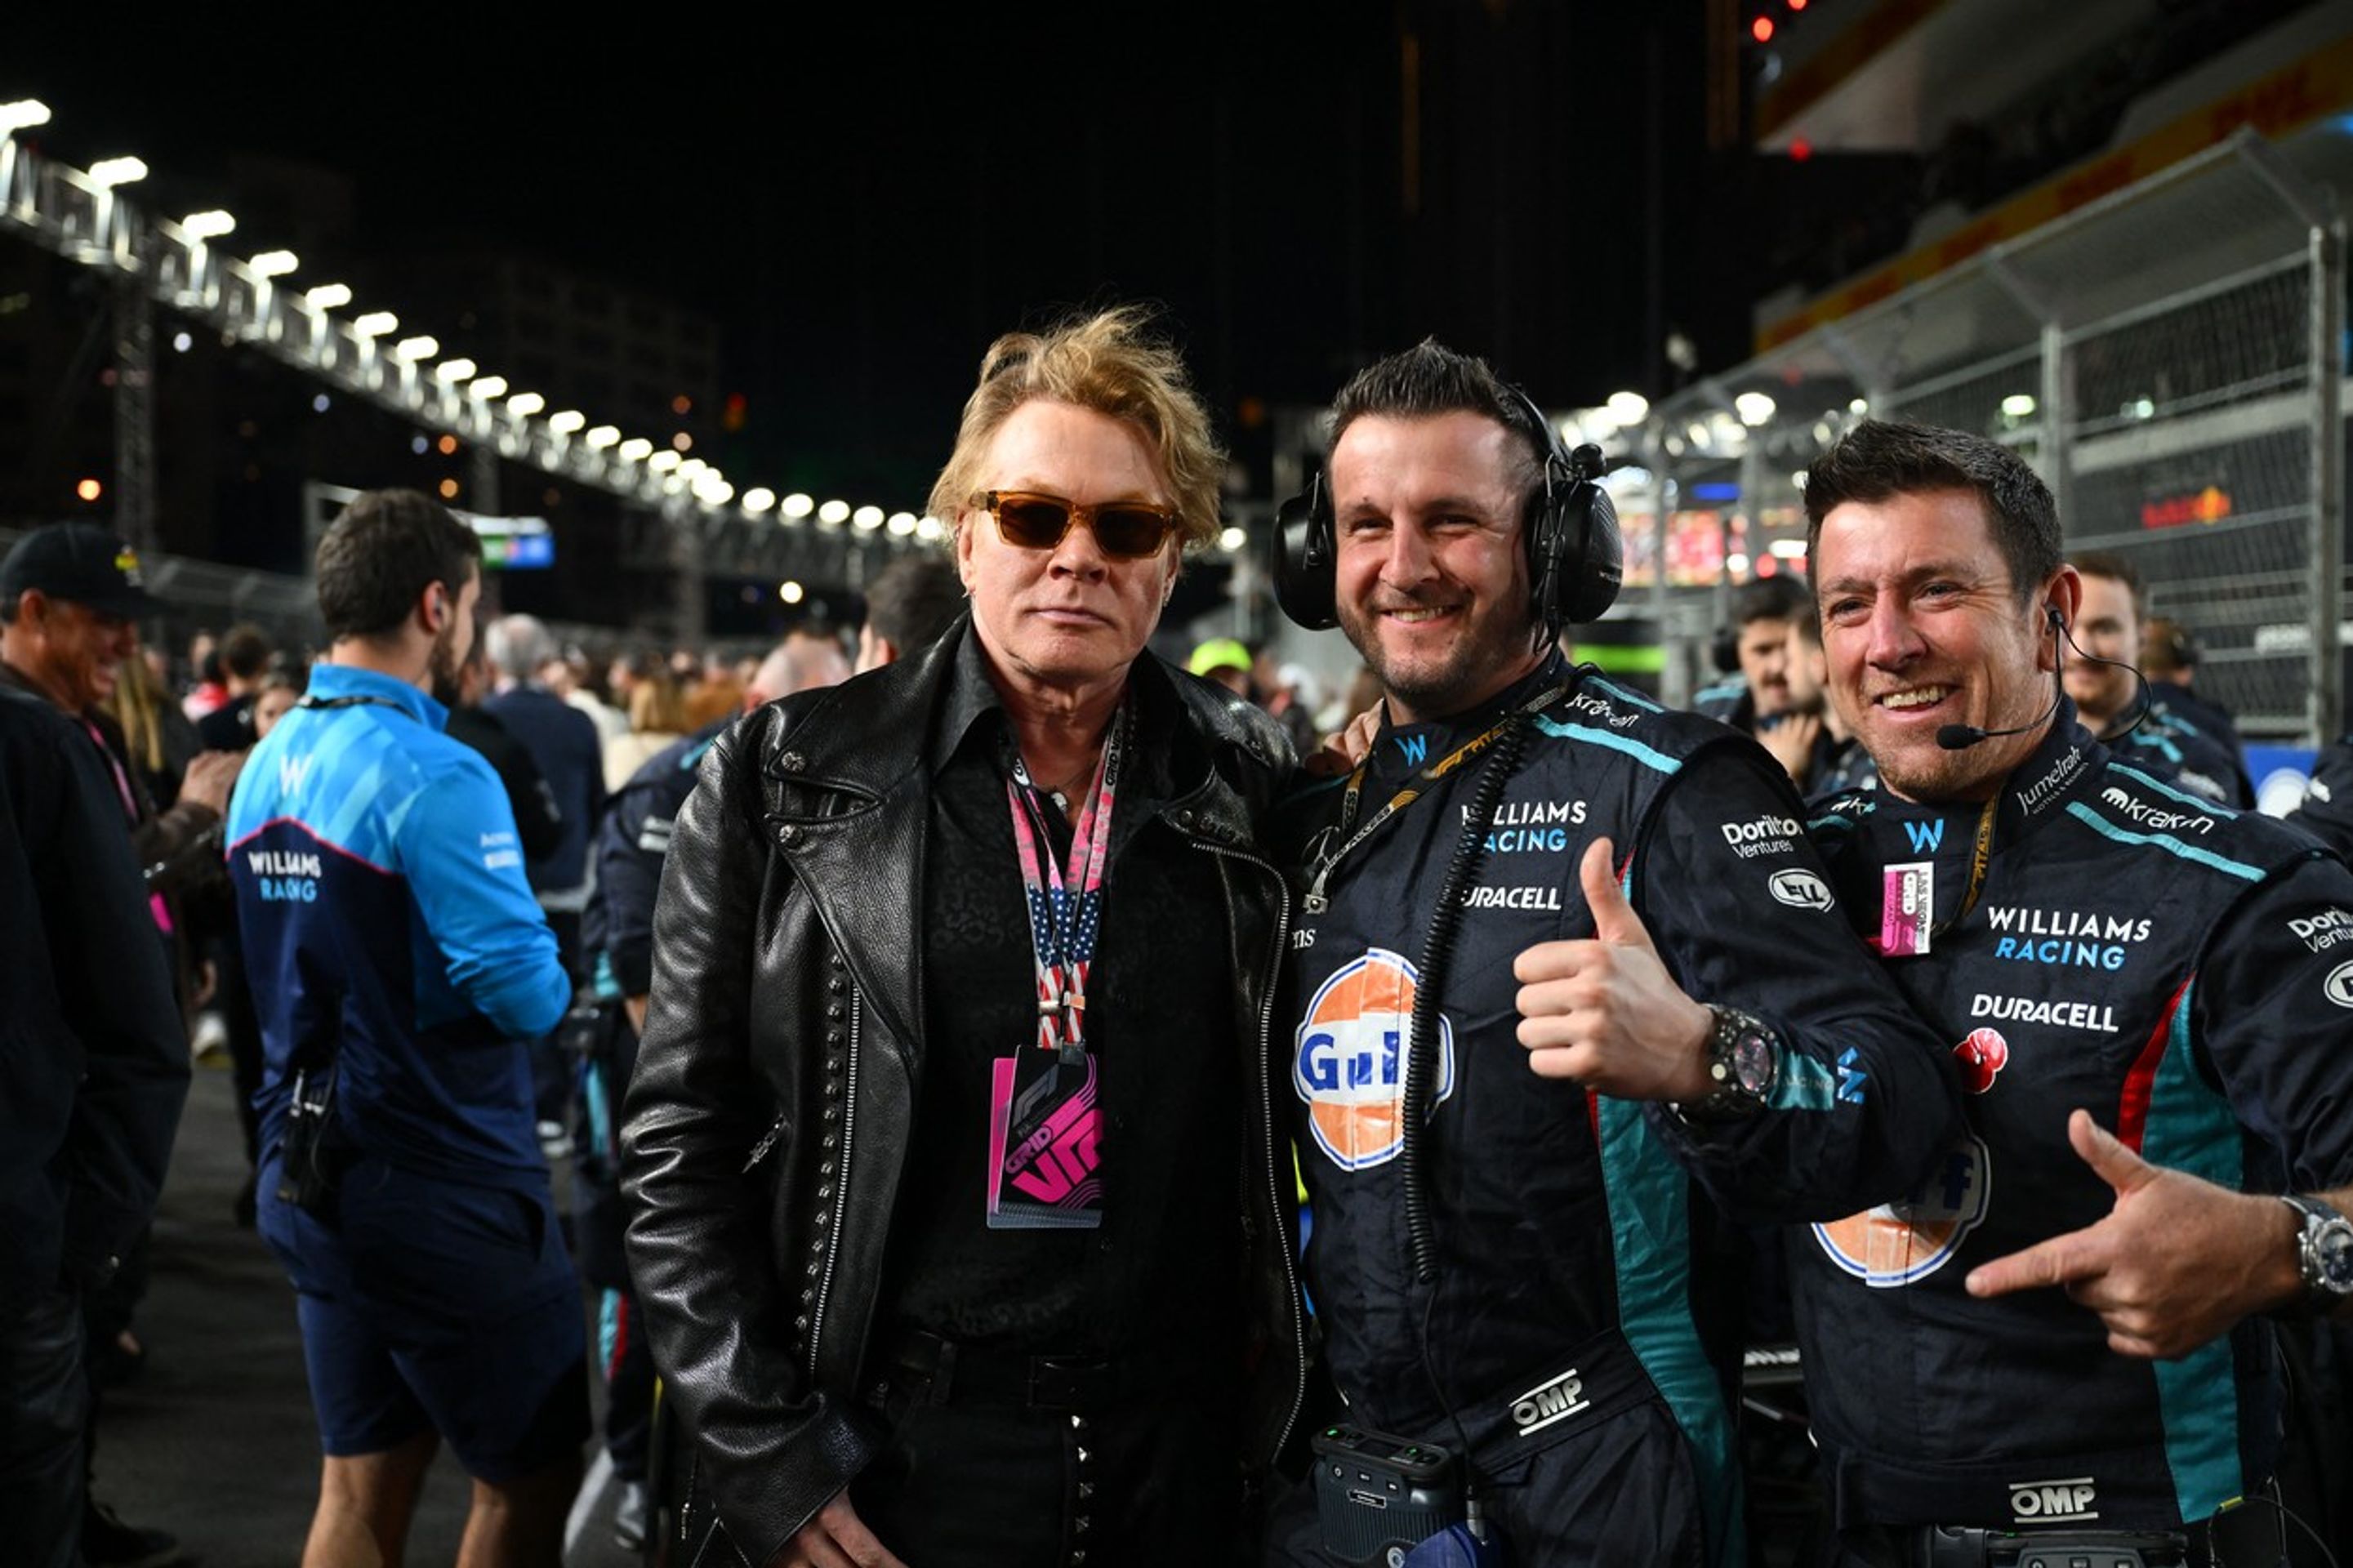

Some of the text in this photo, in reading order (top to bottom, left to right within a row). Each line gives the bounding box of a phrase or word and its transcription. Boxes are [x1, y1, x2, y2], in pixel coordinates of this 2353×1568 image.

[1460, 800, 1588, 826] LLIAMS
[1482, 827, 1567, 853] ACING
[1731, 839, 1794, 859] Ventures
[1903, 818, 1945, 854] W
[1460, 886, 1562, 911] URACELL
[1987, 906, 2153, 943] WILLIAMS
[1994, 937, 2126, 972] RACING
[1970, 993, 2120, 1034] DURACELL
[1299, 1031, 1402, 1091] Gul
[1005, 1126, 1054, 1174] GRID
[1513, 1377, 1584, 1427] OMP
[2011, 1485, 2097, 1517] OMP
